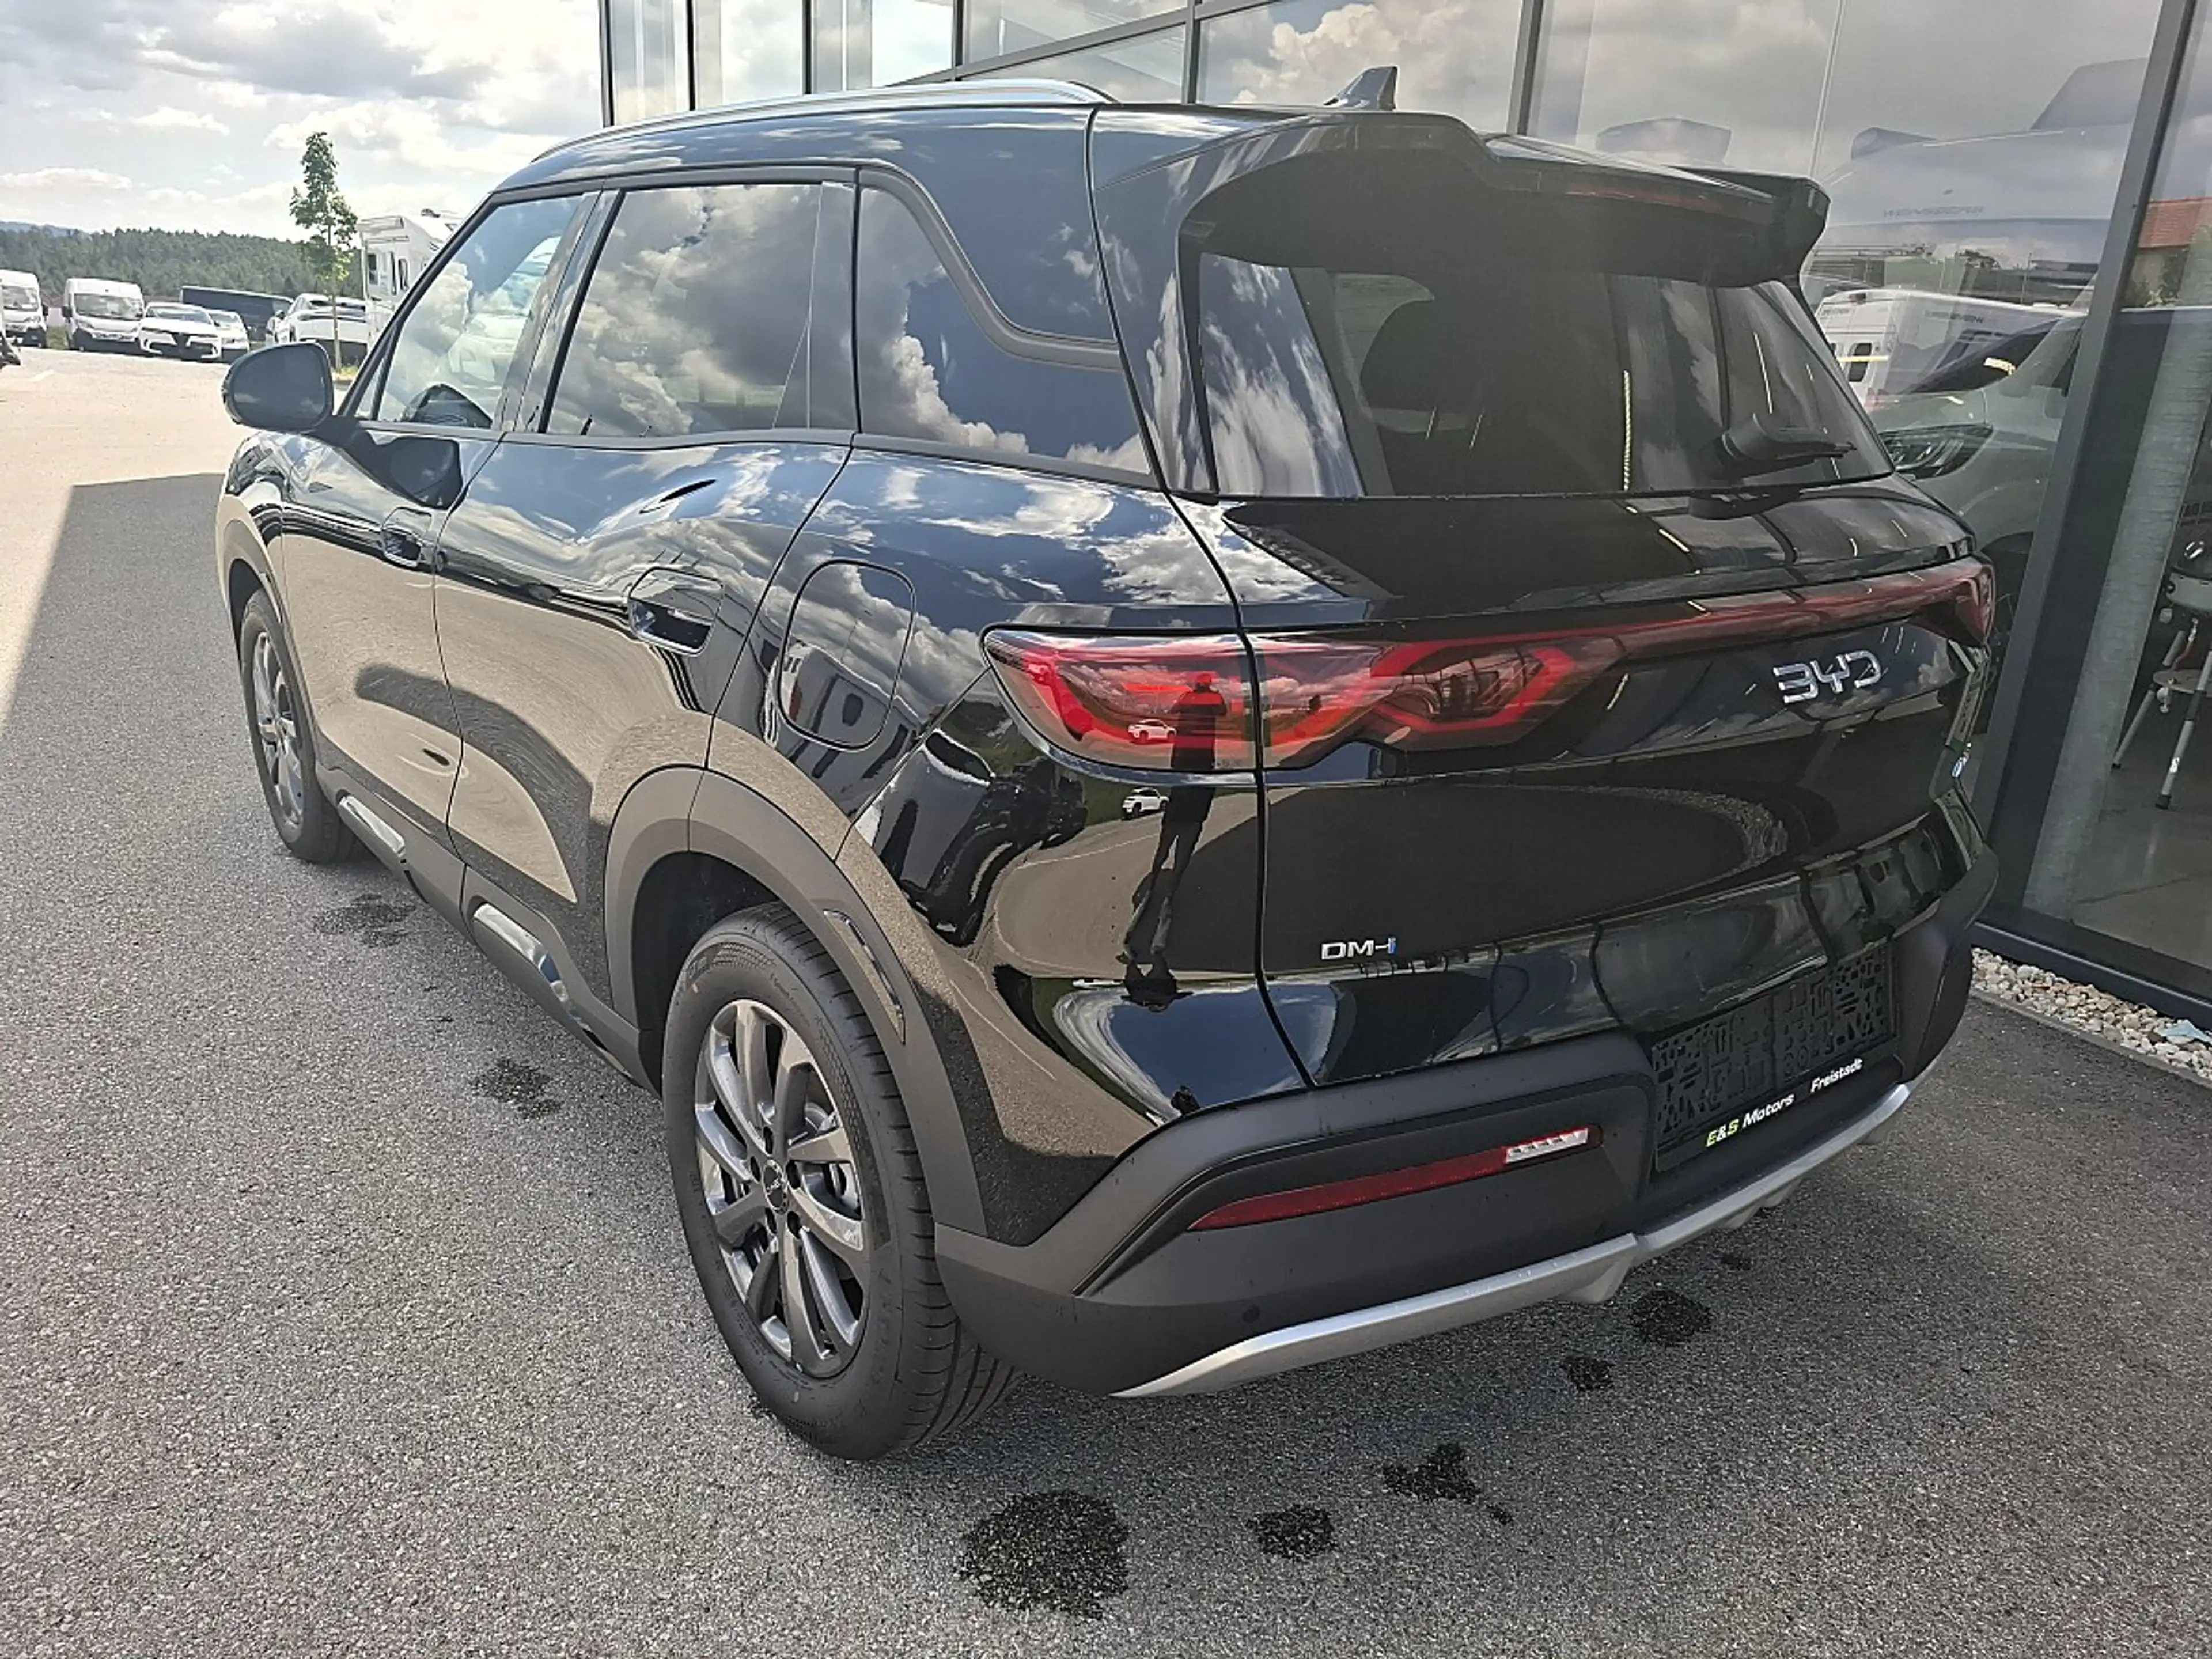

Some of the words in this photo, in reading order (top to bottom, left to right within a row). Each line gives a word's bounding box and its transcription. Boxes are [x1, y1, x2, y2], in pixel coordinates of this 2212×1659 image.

[1773, 650, 1881, 703] BYD
[1705, 1118, 1740, 1147] E&S
[1741, 1094, 1795, 1128] Motors
